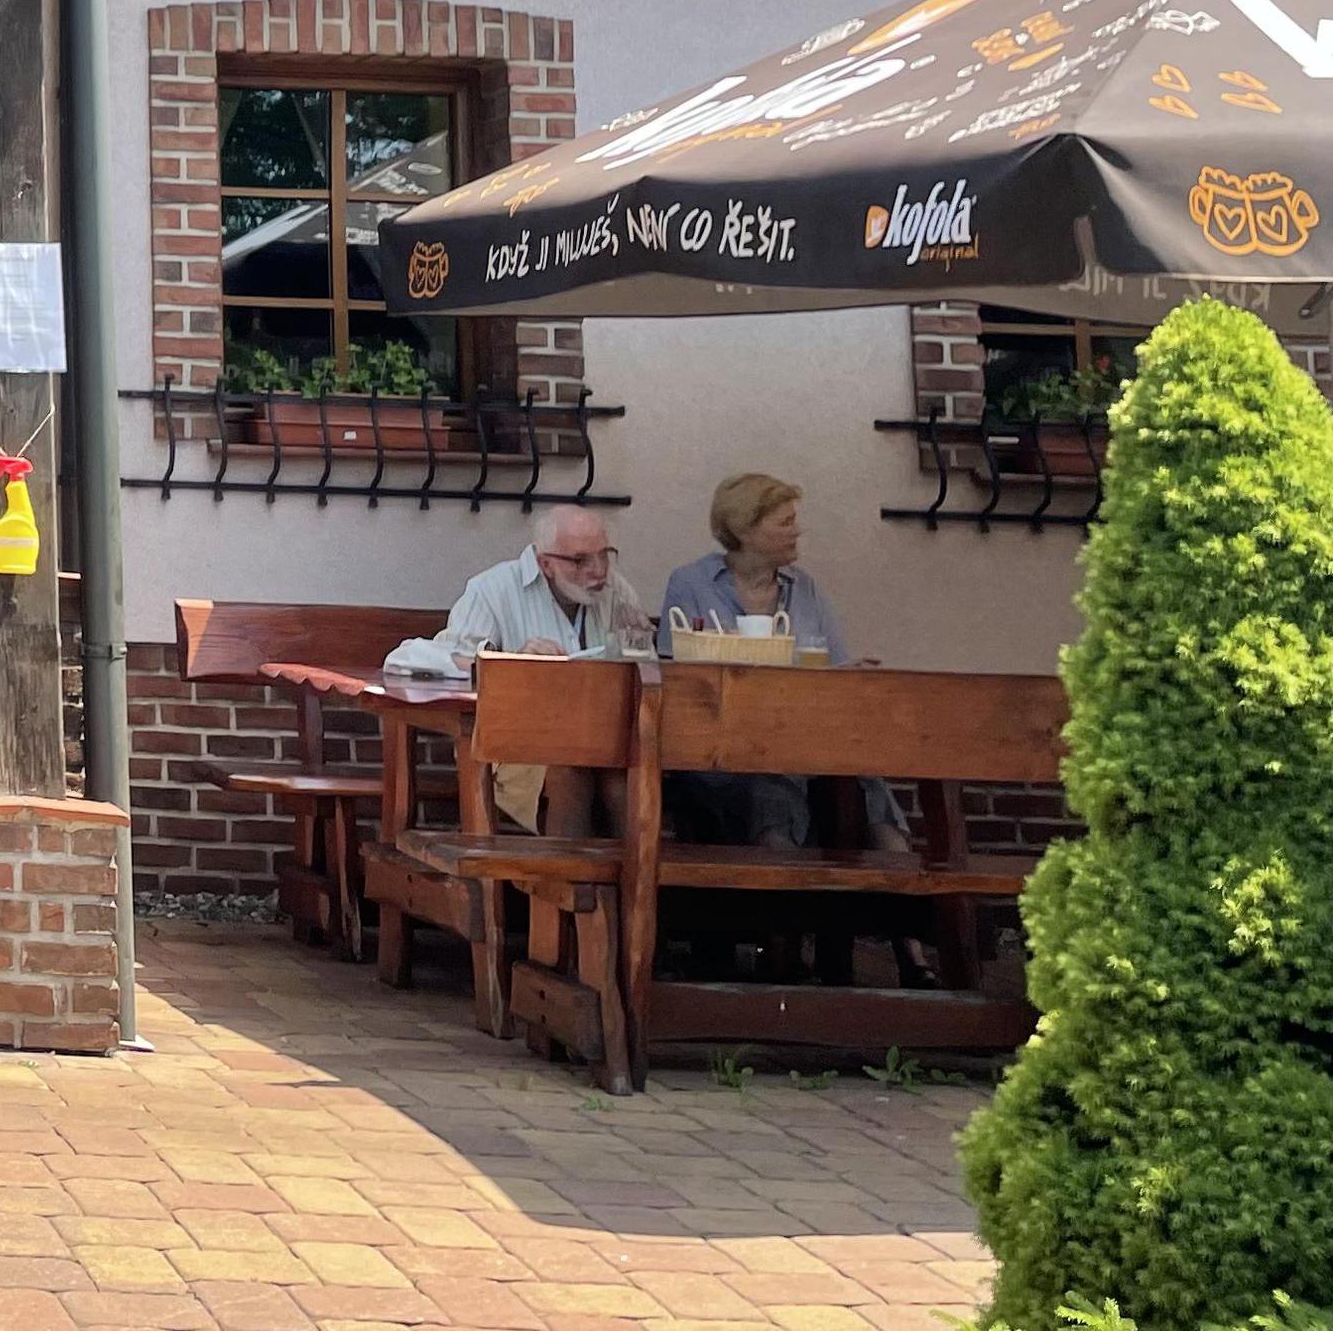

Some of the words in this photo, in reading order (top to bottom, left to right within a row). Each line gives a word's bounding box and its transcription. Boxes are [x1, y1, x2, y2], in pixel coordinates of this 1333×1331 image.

[485, 232, 529, 282] KDYŽ
[536, 241, 550, 271] JI
[556, 194, 619, 271] MILUJEŠ,
[626, 203, 681, 252] NENÍ
[681, 210, 714, 253] CO
[719, 199, 797, 263] ŘEŠIT.
[882, 178, 973, 266] kofola
